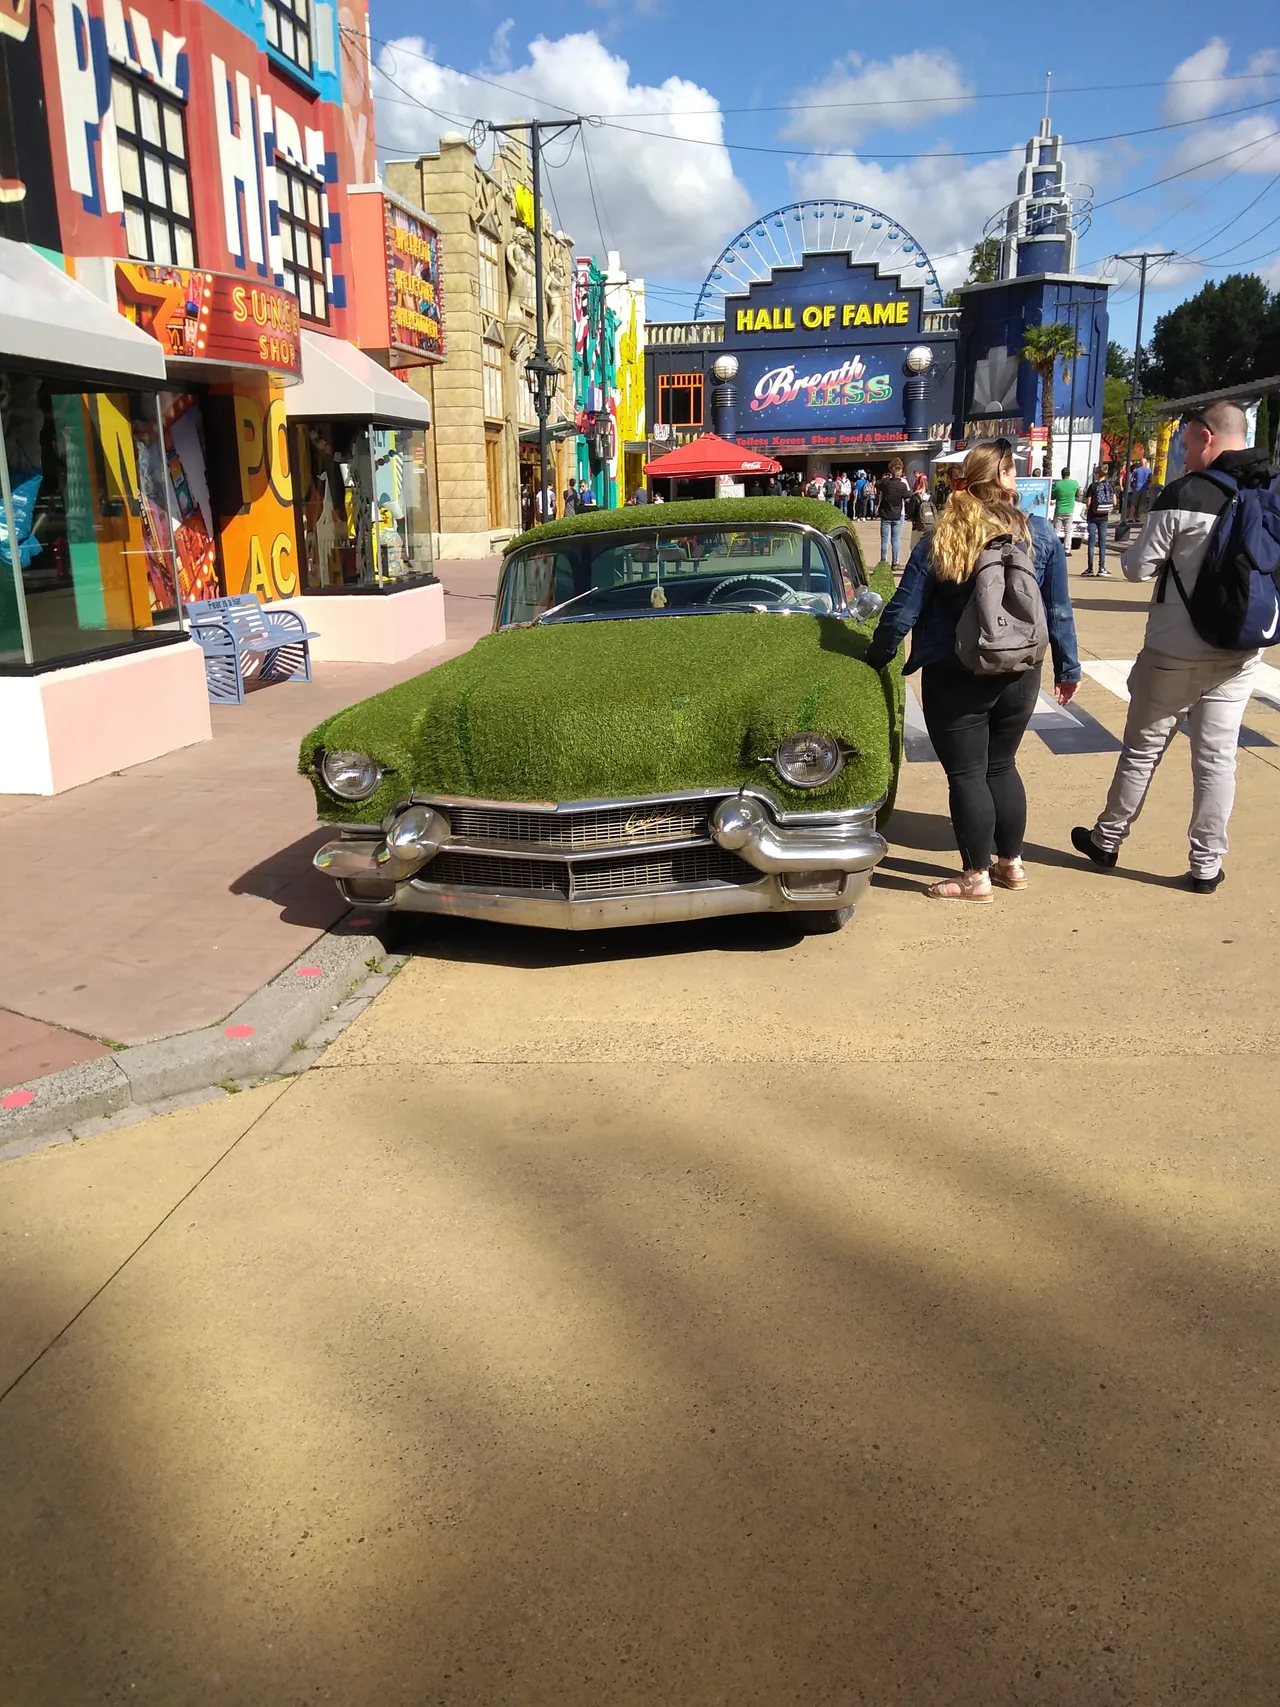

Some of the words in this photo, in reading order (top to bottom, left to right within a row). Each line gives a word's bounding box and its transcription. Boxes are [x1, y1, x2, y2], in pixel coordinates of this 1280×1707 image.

[393, 267, 434, 304] WELCOME
[736, 307, 796, 332] HALL
[802, 304, 836, 328] OF
[842, 301, 909, 327] FAME
[259, 334, 296, 366] SHOP
[750, 354, 866, 411] Breath
[806, 374, 893, 407] LESS
[736, 437, 768, 447] Toilets
[772, 436, 806, 447] Xpress
[811, 435, 836, 446] Shop
[839, 433, 863, 444] Food
[864, 432, 873, 442] &
[874, 431, 908, 442] Drinks
[207, 600, 221, 610] Fear
[222, 599, 228, 608] is
[227, 599, 233, 607] a
[231, 597, 241, 606] liar
